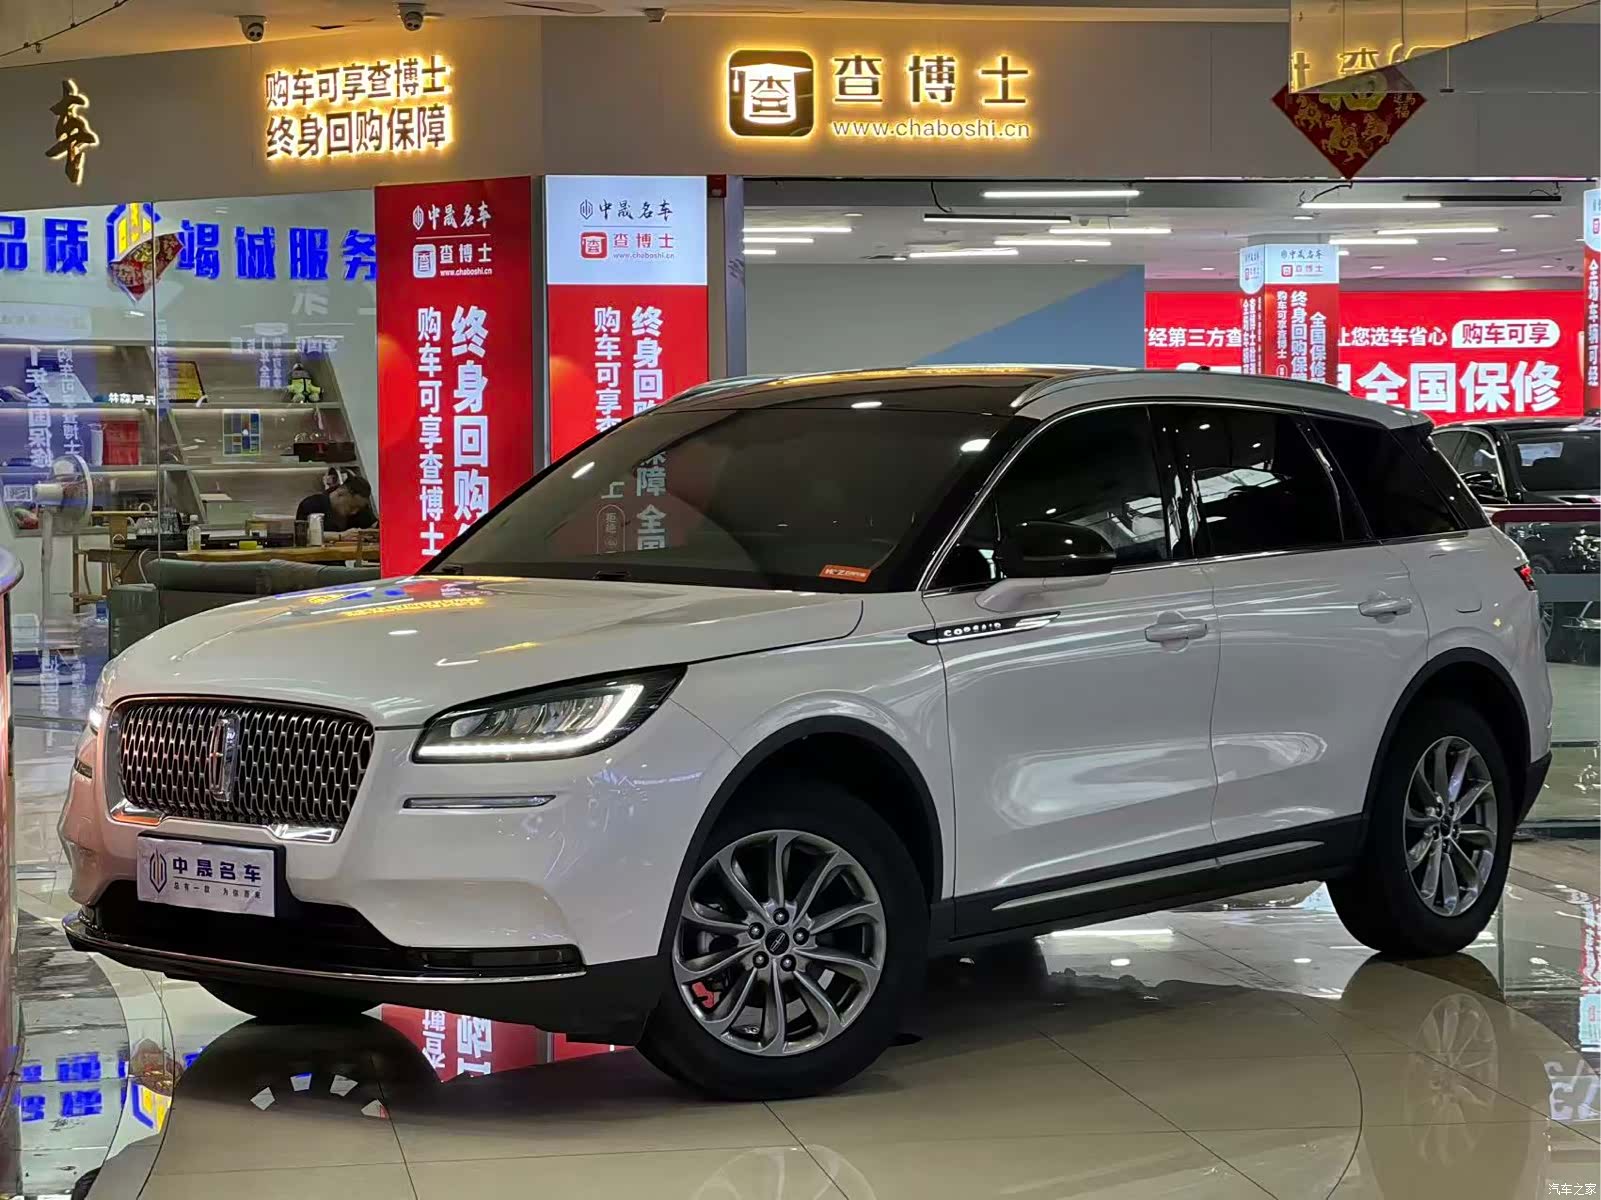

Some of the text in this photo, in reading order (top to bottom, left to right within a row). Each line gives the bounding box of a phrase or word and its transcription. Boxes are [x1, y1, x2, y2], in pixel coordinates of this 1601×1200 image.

[265, 54, 450, 106] 购车可享查博士
[833, 54, 1029, 104] 查博士
[265, 102, 446, 158] 终身回购保障
[832, 119, 1030, 138] www.chaboshi.cn
[428, 200, 491, 230] 中晟名车
[599, 199, 673, 222] 中晟名车
[177, 219, 376, 280] 竭诚服务
[440, 242, 492, 264] 查博士
[613, 232, 674, 249] 查博士
[613, 251, 675, 260] www.chaboshi.cn
[440, 266, 493, 277] www.chaboshi.cn
[1144, 326, 1242, 348] 经第三方查
[1462, 322, 1551, 344] 购车可享
[1310, 312, 1327, 384] 全国保修
[418, 306, 444, 557] 购车可享查博士
[451, 305, 490, 537] 终身回购
[172, 856, 262, 883] 中晟名车
